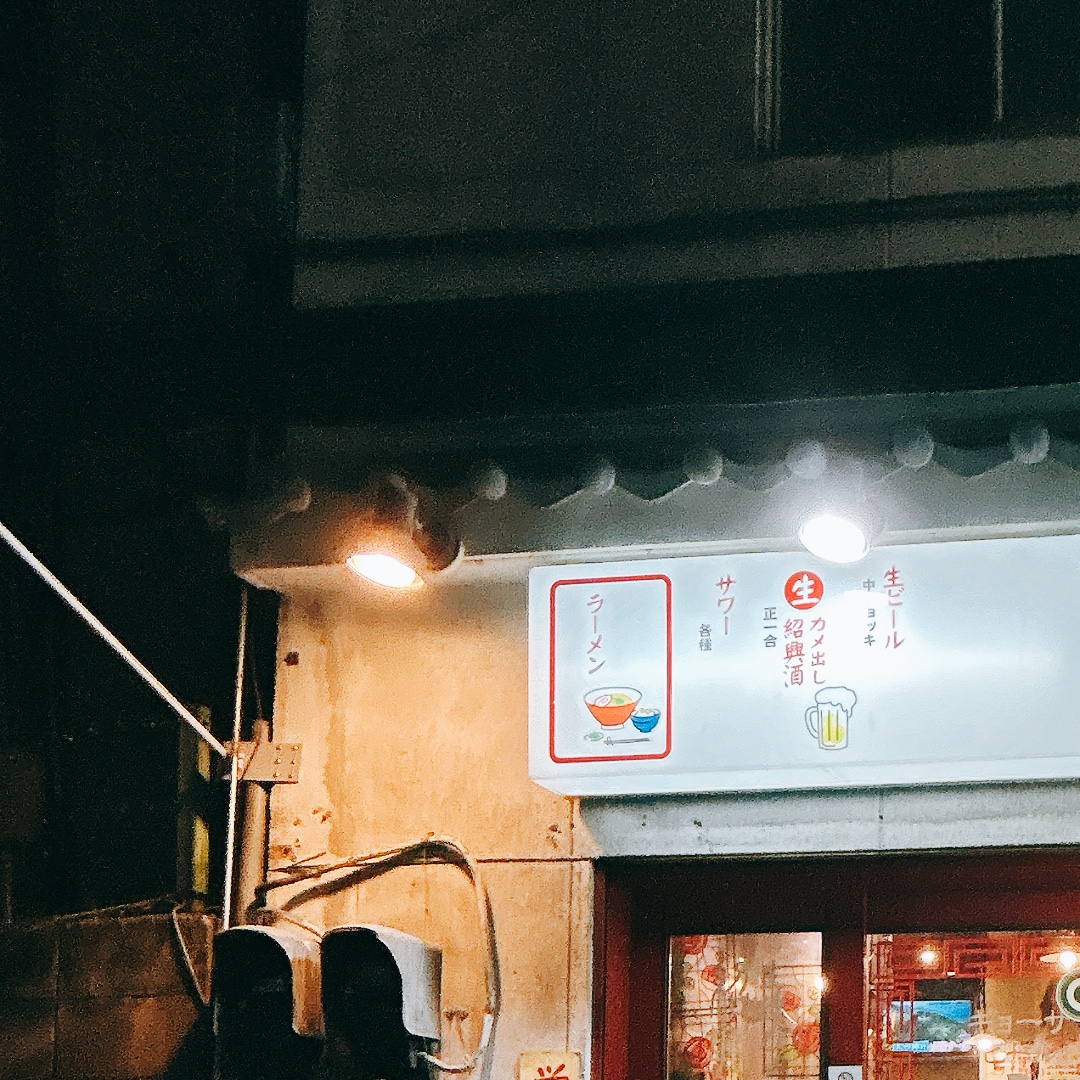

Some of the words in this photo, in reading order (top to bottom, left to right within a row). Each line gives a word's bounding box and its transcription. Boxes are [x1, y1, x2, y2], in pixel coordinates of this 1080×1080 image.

[715, 574, 736, 636] サワー
[791, 576, 820, 606] 生
[862, 577, 877, 648] 中ョッキ
[883, 564, 905, 650] 生ビール
[586, 593, 606, 675] ラーメン
[699, 623, 712, 652] 各種
[763, 606, 778, 649] 正一合
[783, 617, 806, 688] 紹興酒
[810, 616, 826, 685] カメ出し
